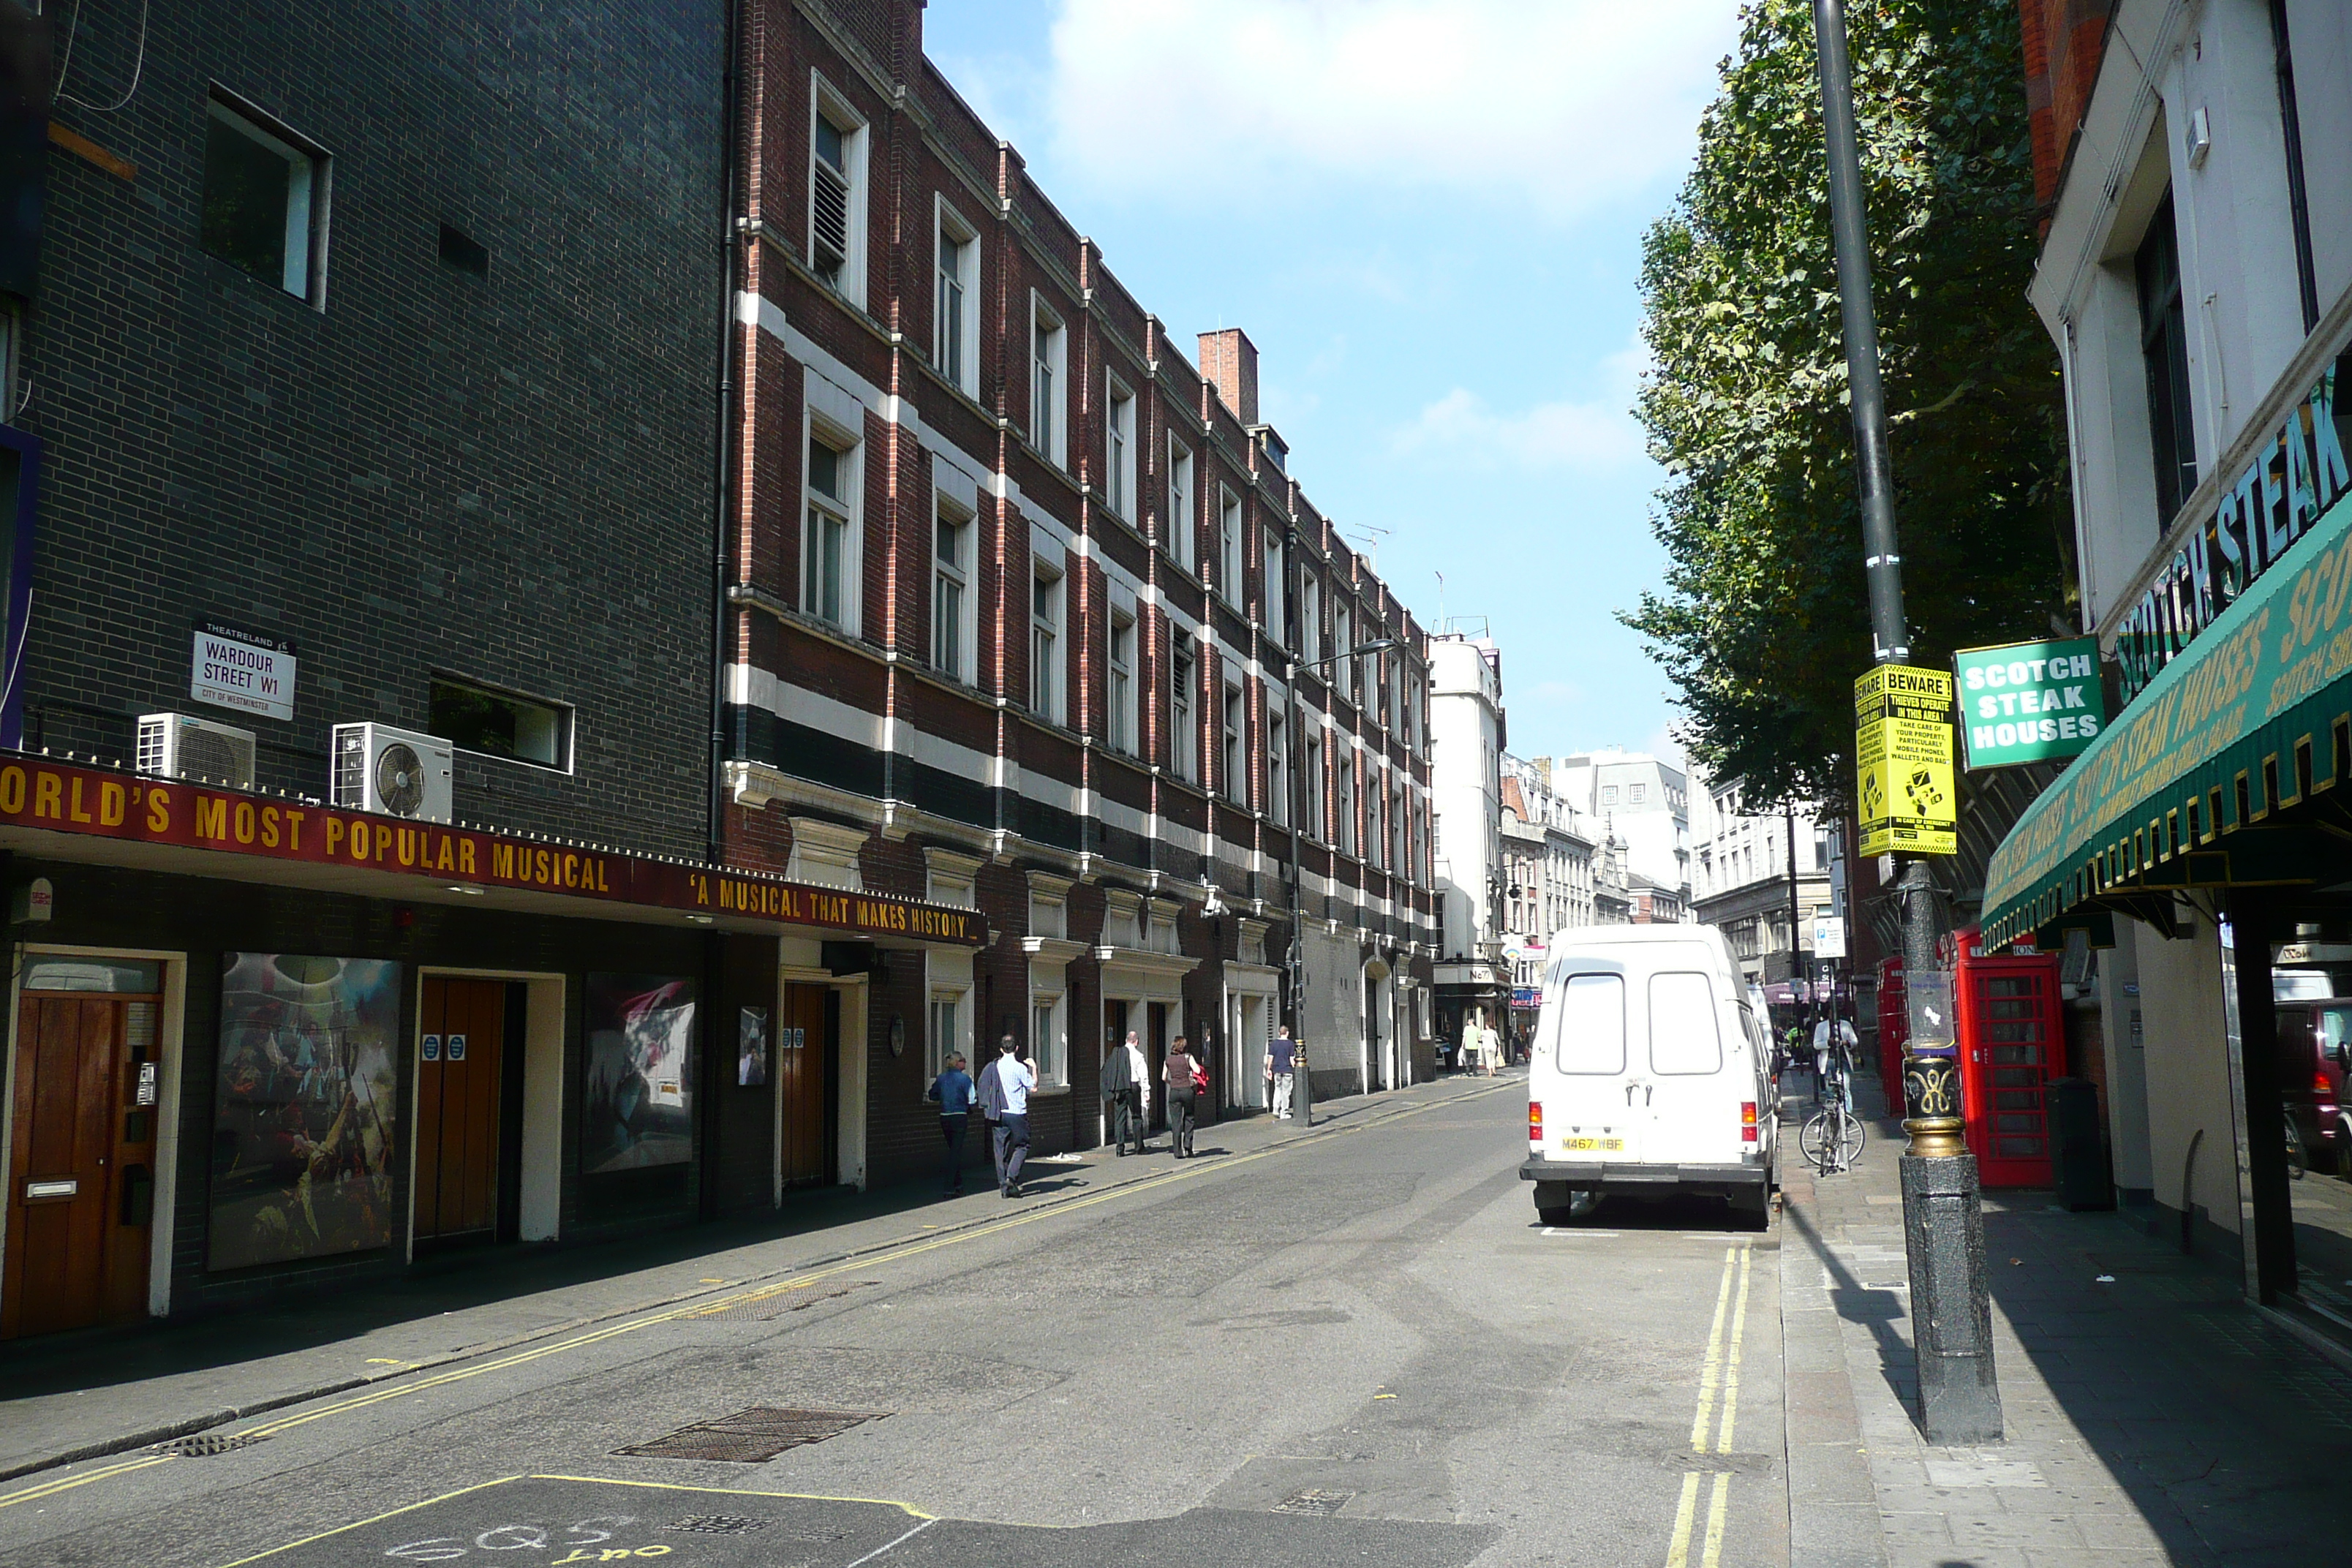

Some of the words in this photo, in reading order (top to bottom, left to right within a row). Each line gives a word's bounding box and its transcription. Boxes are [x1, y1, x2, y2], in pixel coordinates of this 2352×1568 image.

[2116, 522, 2215, 706] SCOTCH
[2217, 359, 2351, 603] STEAK
[206, 622, 274, 647] THEATRELAND
[205, 641, 274, 674] WARDOUR
[203, 662, 253, 688] STREET
[260, 676, 278, 696] W1
[1965, 654, 2092, 690] SCOTCH
[1888, 673, 1943, 695] BEWARE
[2122, 683, 2180, 781] STEAK
[2173, 607, 2269, 744] HOUSES
[202, 689, 216, 700] CITY
[217, 693, 226, 702] OF
[227, 694, 269, 711] WESTMINSTER
[1891, 694, 1920, 708] THIEVES
[1921, 698, 1950, 712] OPERATE
[1978, 685, 2086, 719] STEAK
[1897, 706, 1905, 717] IN
[1906, 708, 1922, 720] THIS
[1896, 728, 1913, 736] YOUR
[1899, 720, 1915, 728] TAKE
[1917, 723, 1933, 731] CARE
[1972, 714, 2098, 750] HOUSES
[1896, 745, 1920, 753] MOBILE
[1899, 736, 1942, 747] PARTICULARLY
[1891, 753, 1920, 761] WALLETS
[195, 795, 305, 851] MOST
[326, 816, 475, 875] POPULAR
[492, 843, 608, 893] MUSICAL
[720, 878, 801, 918] MUSICAL
[810, 892, 848, 924] THAT
[856, 900, 906, 931] MAKES
[1562, 1138, 1594, 1149] M467
